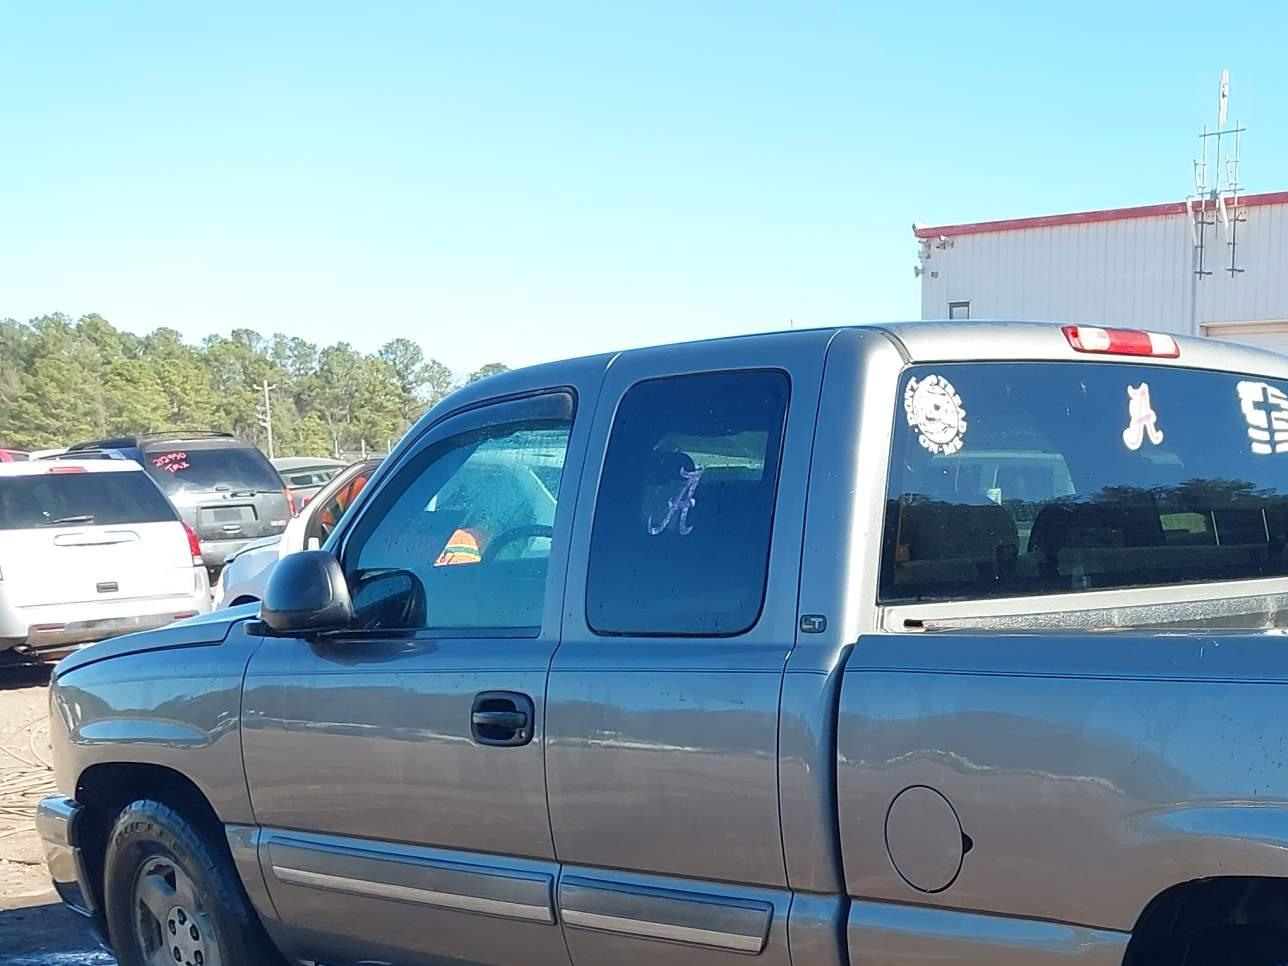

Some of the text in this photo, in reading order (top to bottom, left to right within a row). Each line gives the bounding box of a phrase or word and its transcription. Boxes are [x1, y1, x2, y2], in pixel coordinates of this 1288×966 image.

[1122, 382, 1164, 451] A
[918, 434, 940, 455] ON
[942, 436, 964, 457] ME
